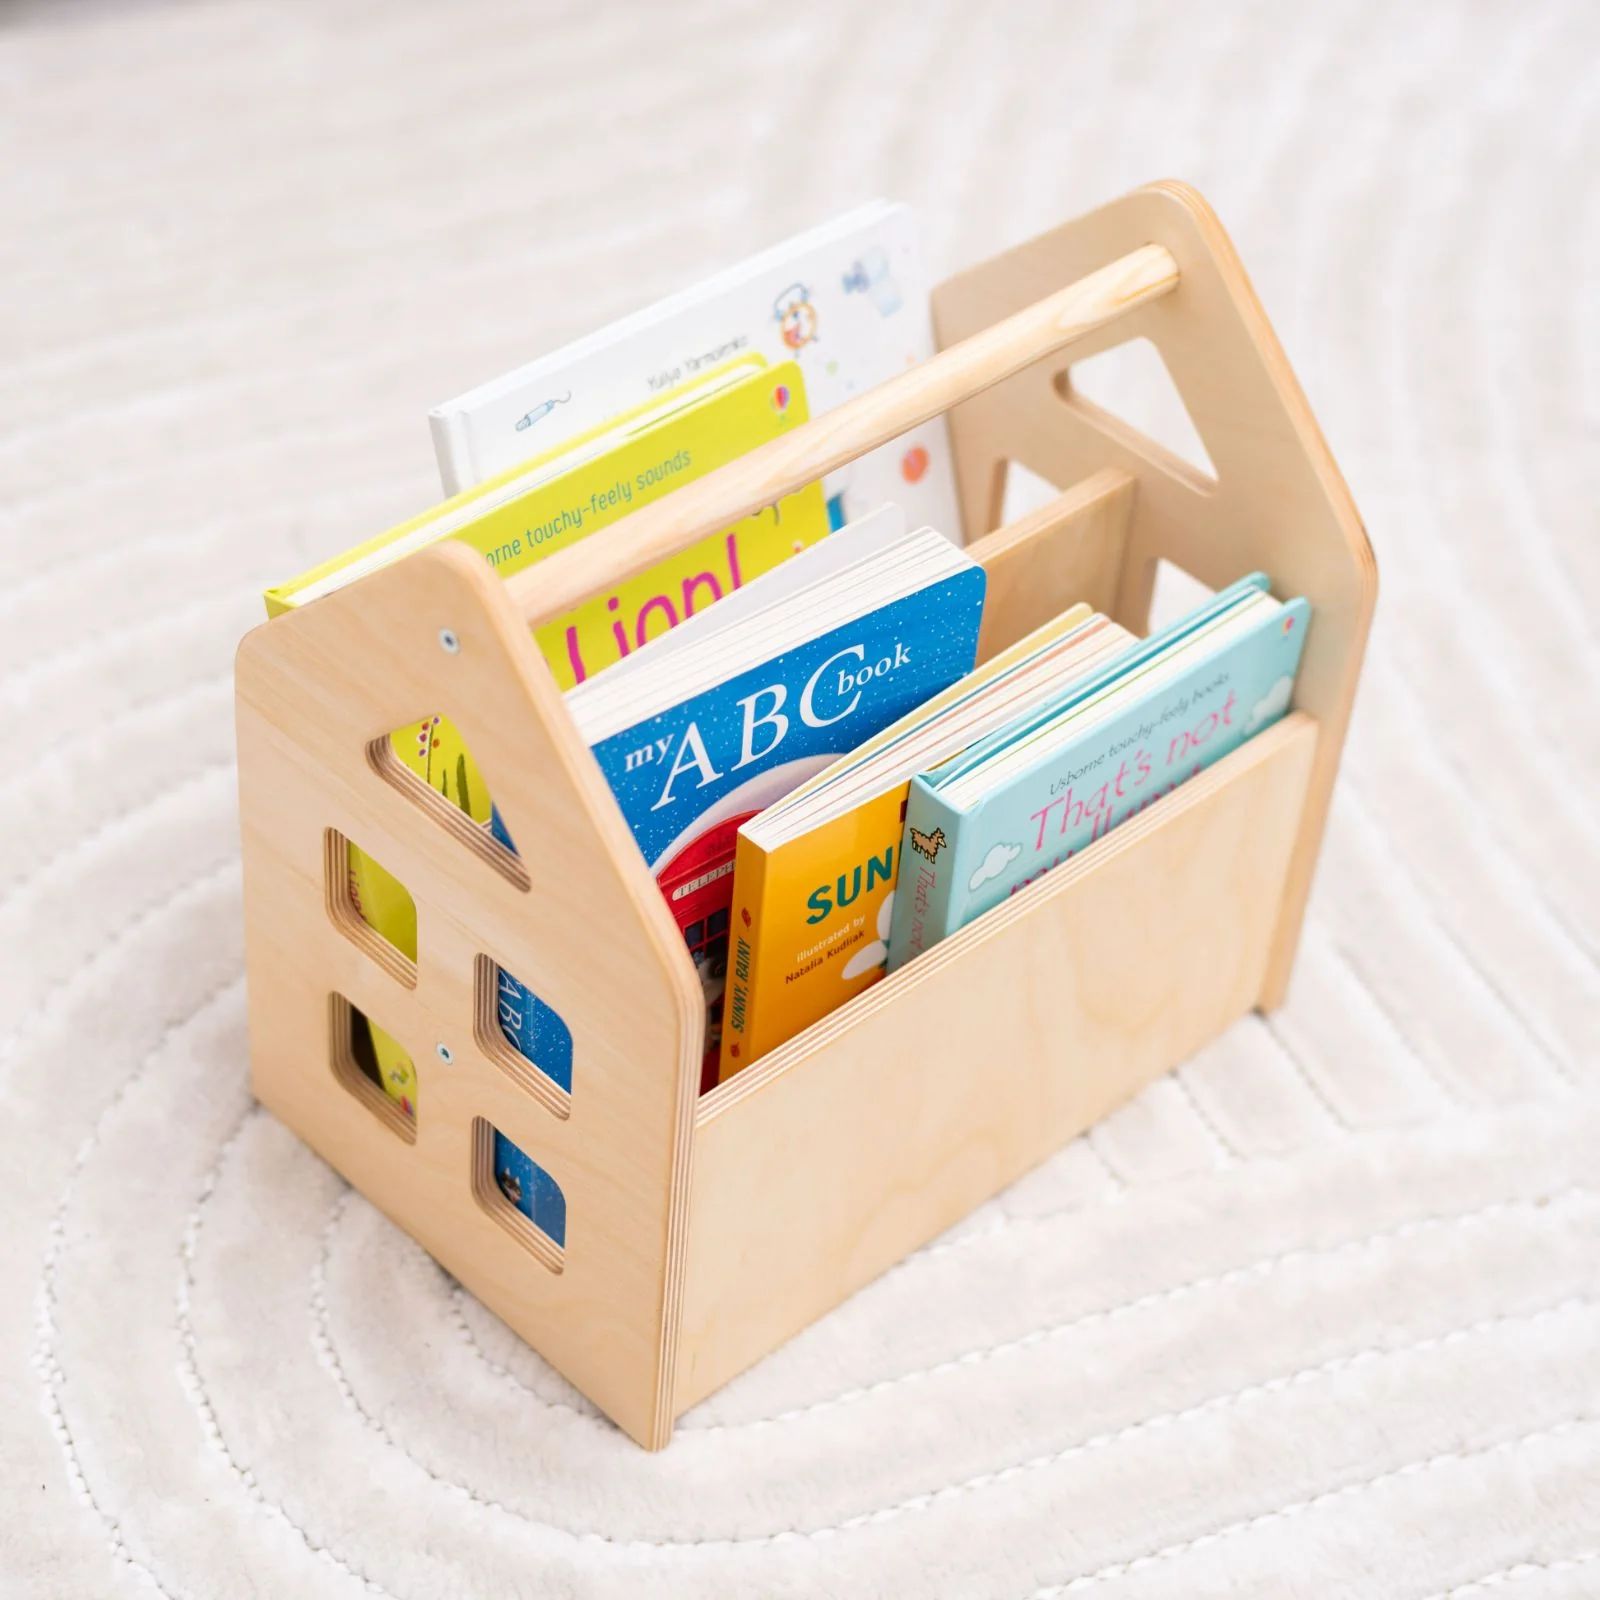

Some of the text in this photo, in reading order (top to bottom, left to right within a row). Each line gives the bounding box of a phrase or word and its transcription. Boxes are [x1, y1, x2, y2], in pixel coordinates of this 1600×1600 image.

[526, 480, 633, 548] touchy-feely
[636, 449, 692, 491] sounds
[624, 643, 912, 812] my ABC book
[1030, 747, 1152, 851] That's
[1165, 688, 1239, 766] not
[1049, 752, 1105, 796] Usborne
[1108, 696, 1190, 758] touchy-feely
[806, 840, 903, 925] SUN
[731, 936, 752, 1035] SUNNY, RAINY
[784, 956, 824, 985] Natalia
[826, 929, 866, 960] Kudliak
[796, 912, 867, 963] illustrated by
